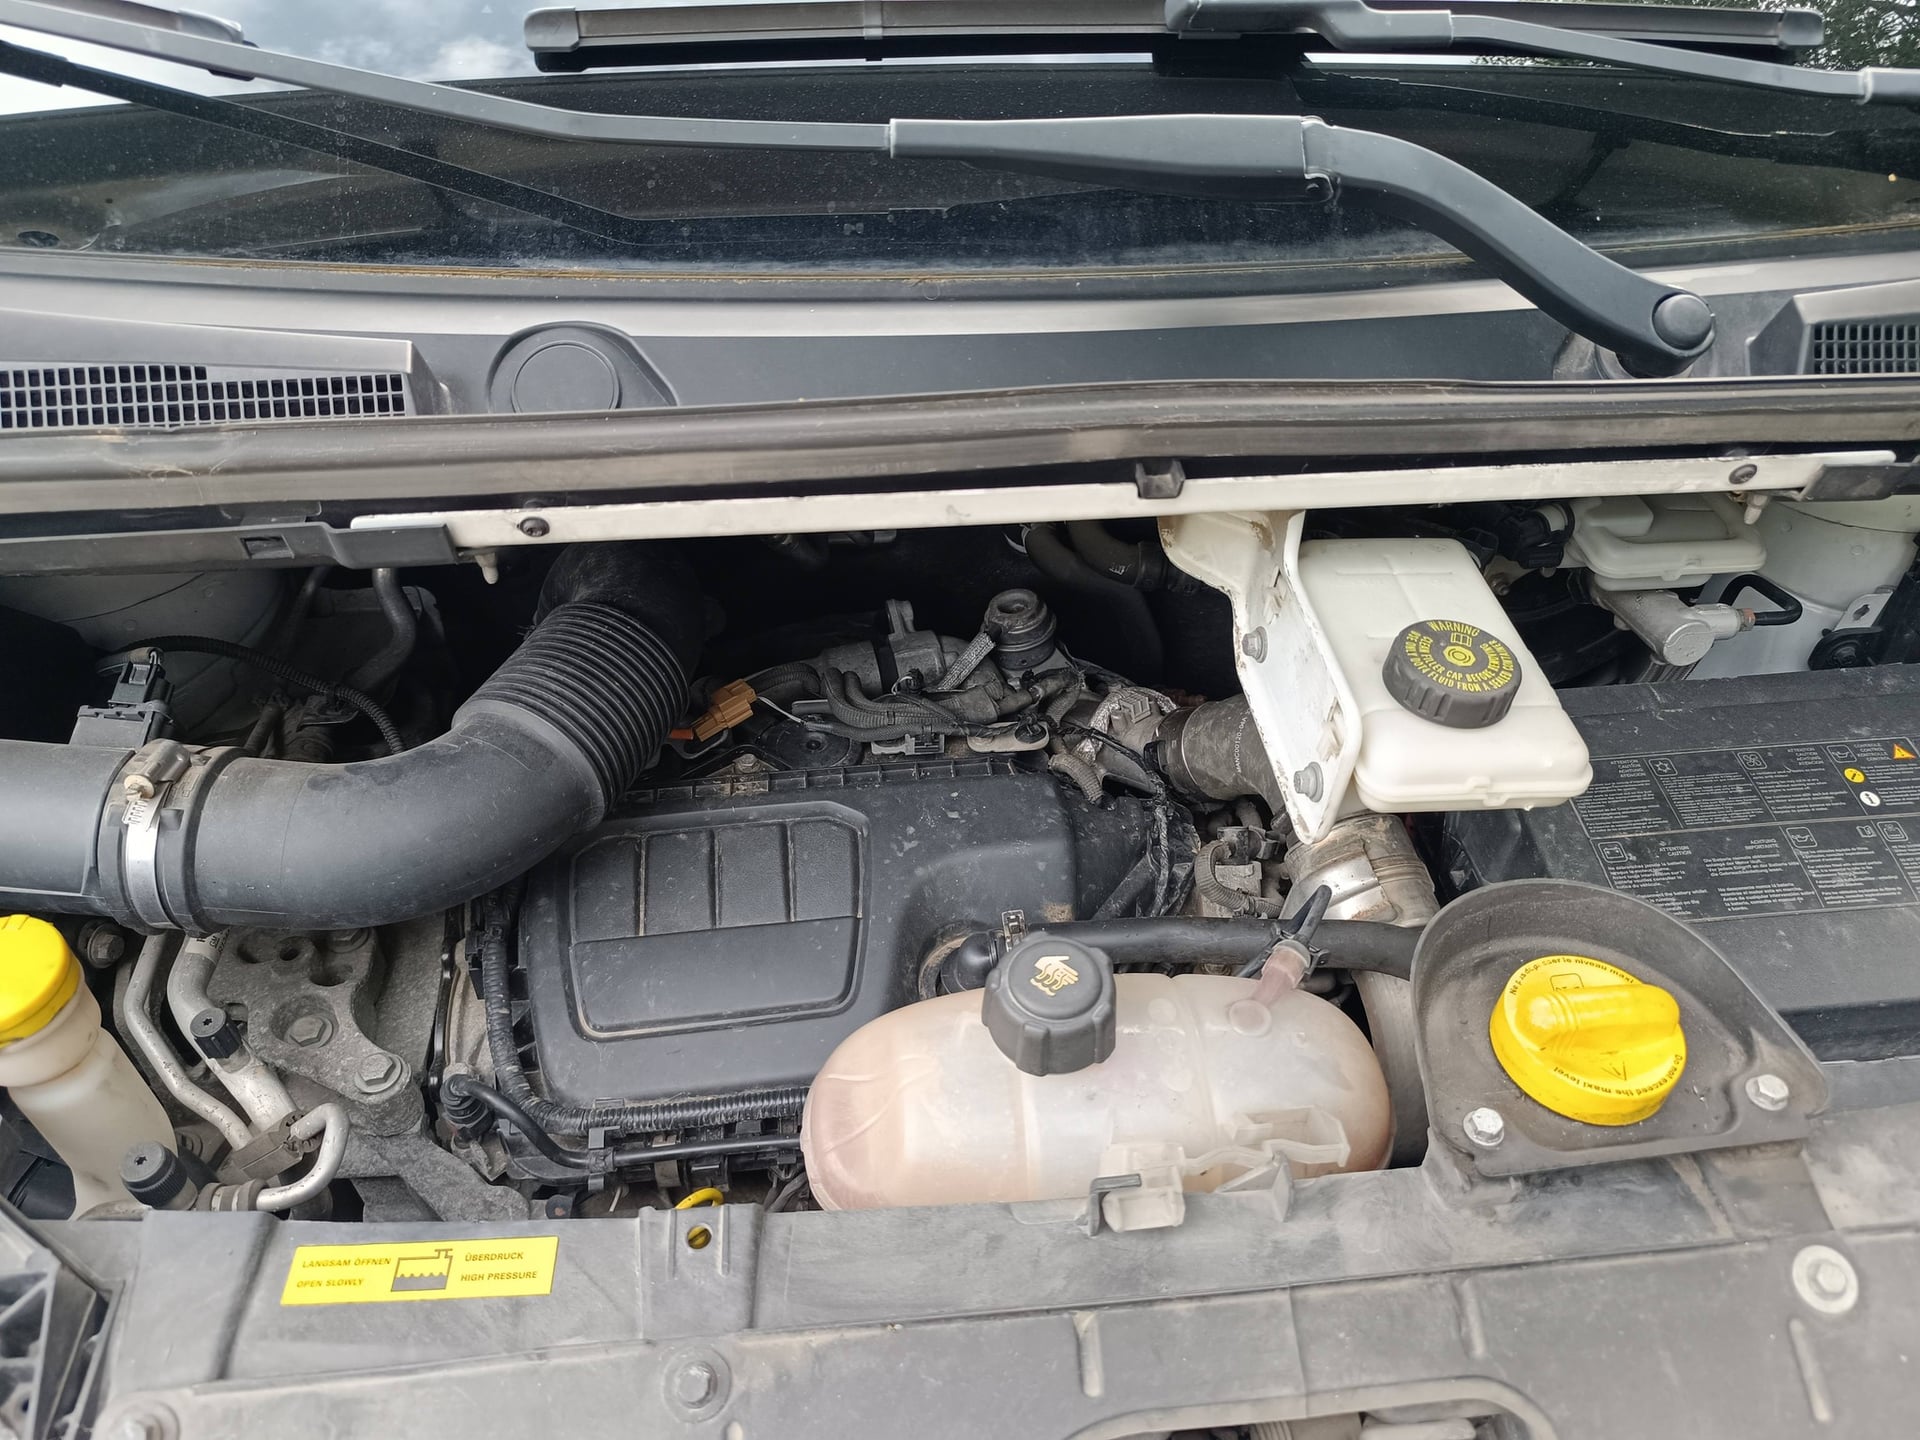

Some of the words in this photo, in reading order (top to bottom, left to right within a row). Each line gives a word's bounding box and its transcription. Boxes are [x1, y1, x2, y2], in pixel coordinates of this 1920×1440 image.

[1427, 621, 1480, 636] WARNING
[1421, 654, 1445, 672] FILLER
[1446, 670, 1463, 680] CAP
[1466, 668, 1496, 682] BEFORE
[1428, 672, 1454, 688] FLUID
[1457, 682, 1482, 692] FROM
[1483, 683, 1491, 692] A
[1575, 958, 1608, 972] niveau
[1610, 968, 1634, 984] maxi
[1553, 1066, 1580, 1086] level
[1582, 1082, 1612, 1094] maxi
[1615, 1089, 1634, 1097] the
[1636, 1078, 1668, 1096] exceed
[302, 1258, 350, 1268] LANGSAM
[354, 1256, 392, 1266] ÖFFNEN
[464, 1252, 524, 1262] ÜBERDRUCK
[460, 1273, 484, 1282] HIGH
[487, 1270, 538, 1280] PRESSURE
[296, 1280, 322, 1288] OPEN
[325, 1278, 364, 1287] SLOWLY
